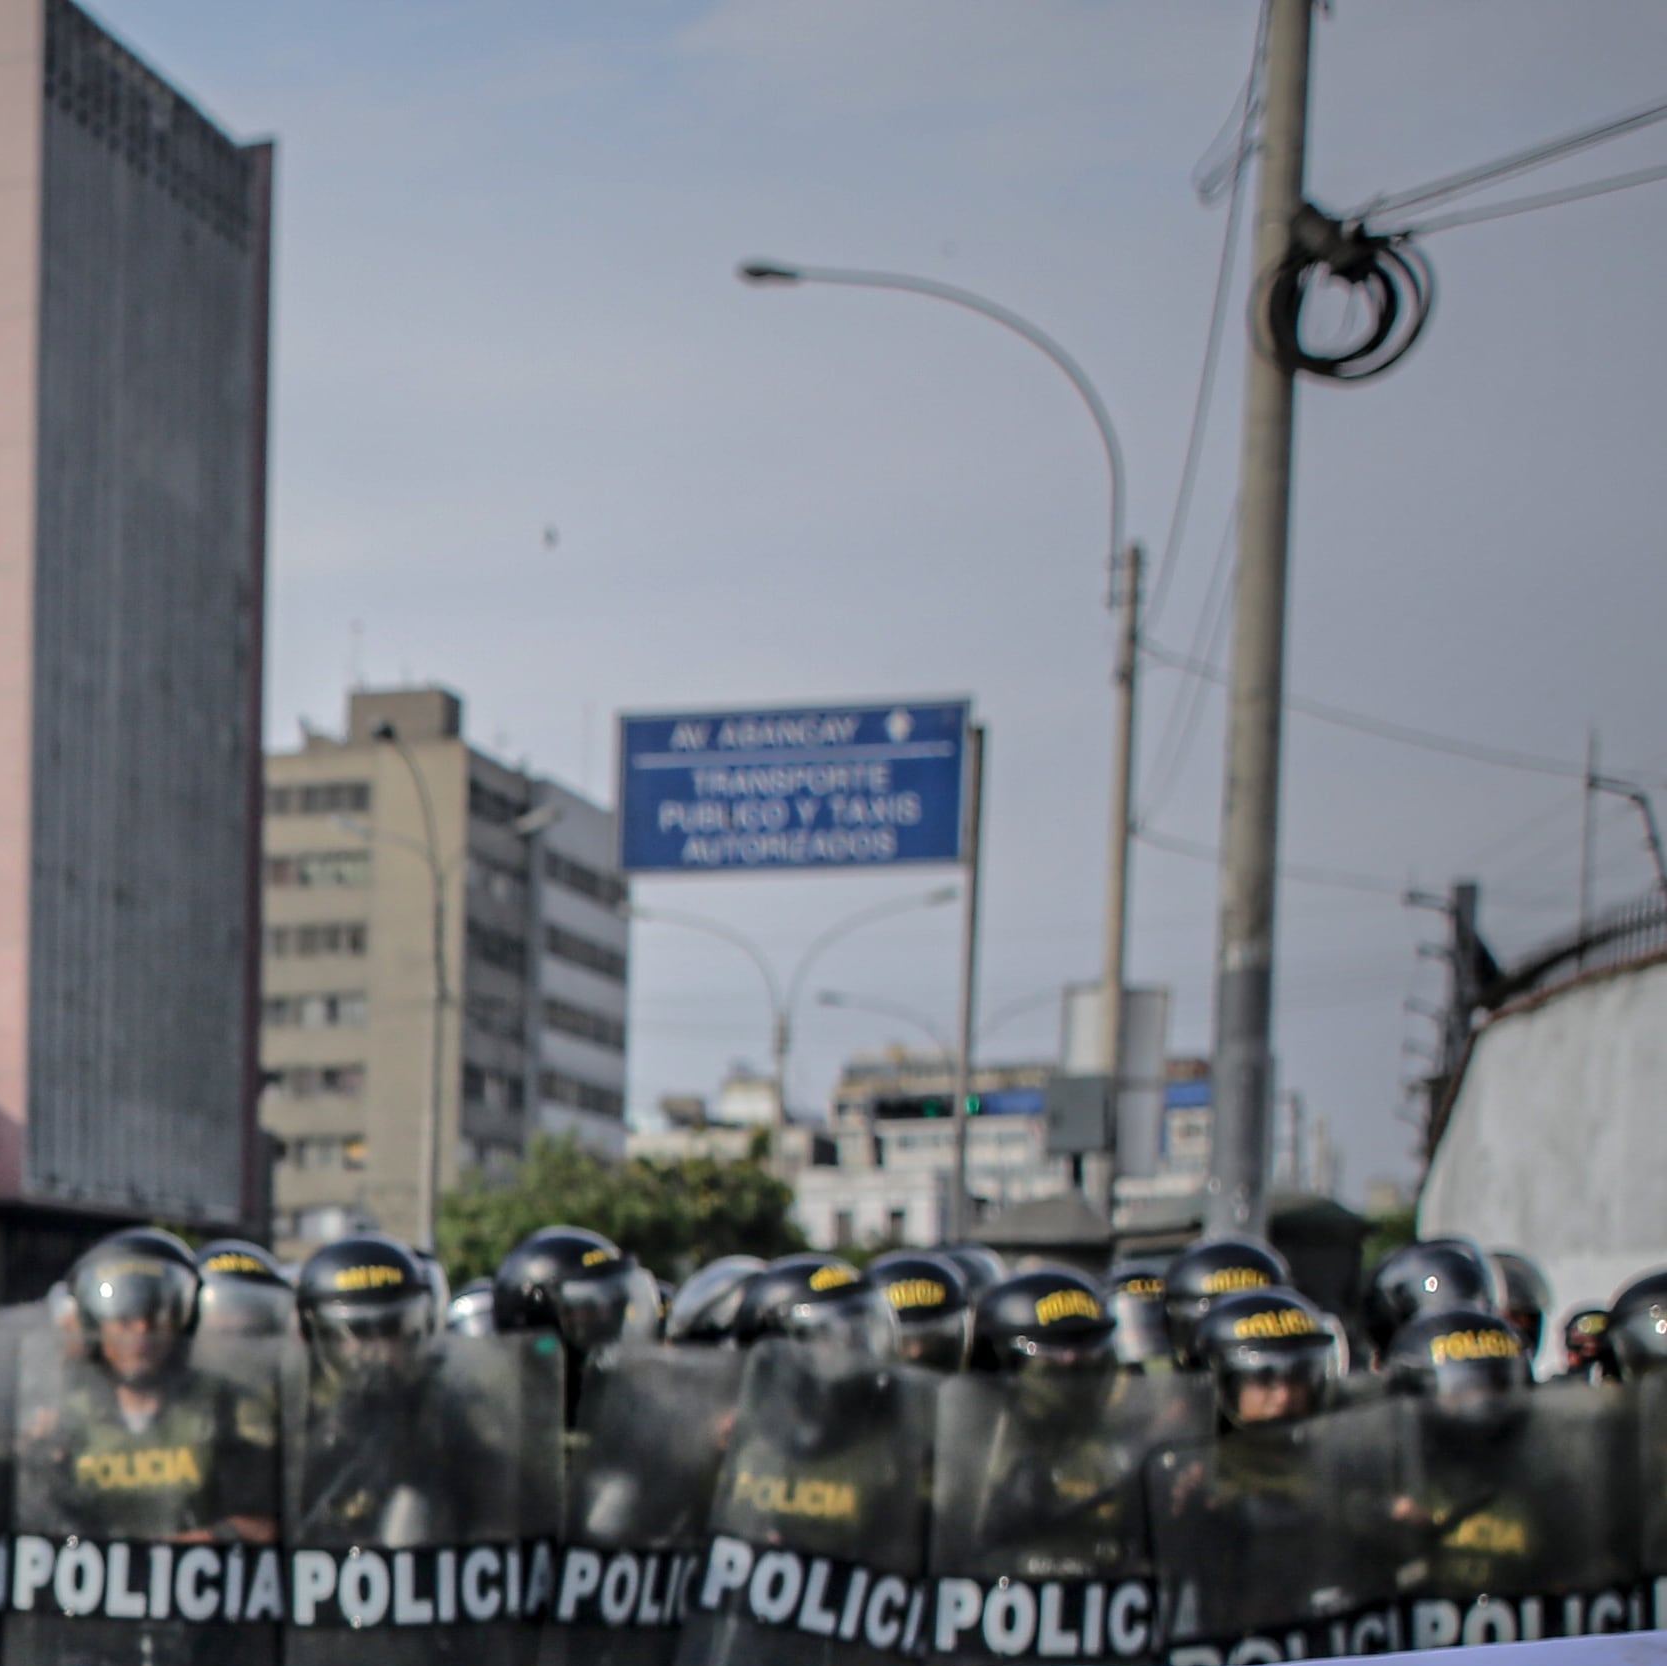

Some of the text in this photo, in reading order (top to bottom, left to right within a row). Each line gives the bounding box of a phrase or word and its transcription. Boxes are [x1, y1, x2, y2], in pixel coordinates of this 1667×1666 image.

[671, 716, 859, 749] AV ABANCAY
[692, 763, 890, 795] TRANSPORTE
[795, 800, 820, 826] Y
[828, 792, 921, 825] TAXIS
[681, 828, 897, 862] AUTORIZADOS
[76, 1447, 202, 1490] POLICIA
[13, 1535, 284, 1620] POLICIA
